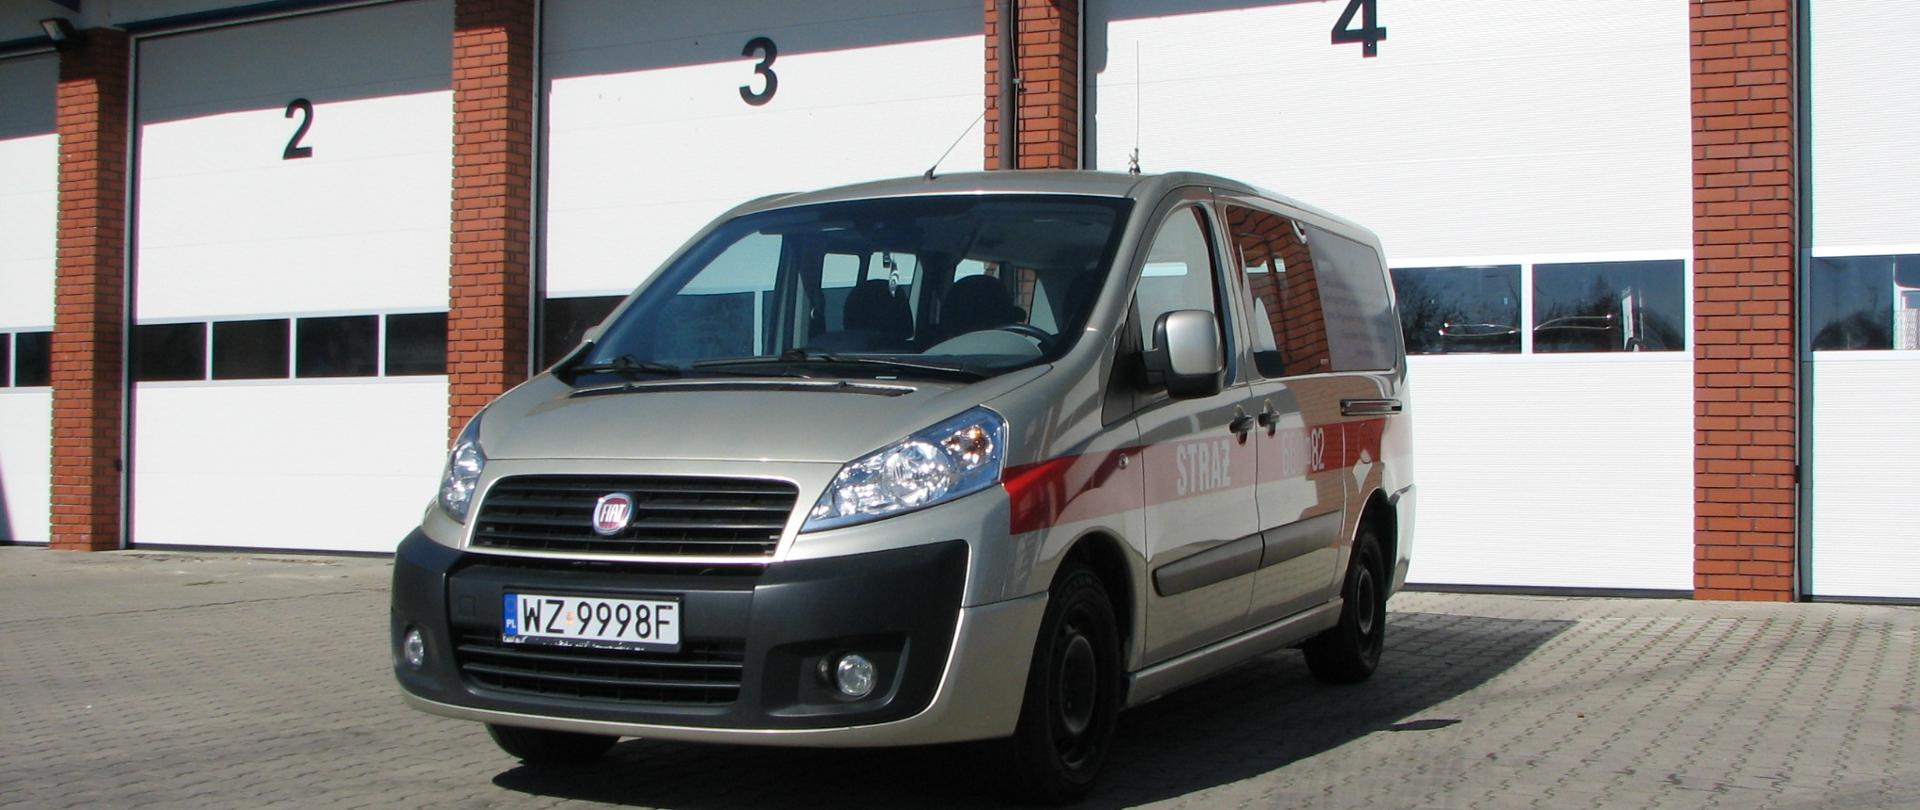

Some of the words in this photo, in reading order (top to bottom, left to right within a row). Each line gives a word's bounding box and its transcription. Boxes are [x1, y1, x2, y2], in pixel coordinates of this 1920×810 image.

[1331, 0, 1386, 57] 4
[739, 36, 778, 106] 3
[282, 97, 313, 160] 2
[600, 503, 627, 523] FIAT
[506, 619, 517, 629] PL
[523, 598, 564, 634] WZ
[577, 601, 673, 639] 9998F
